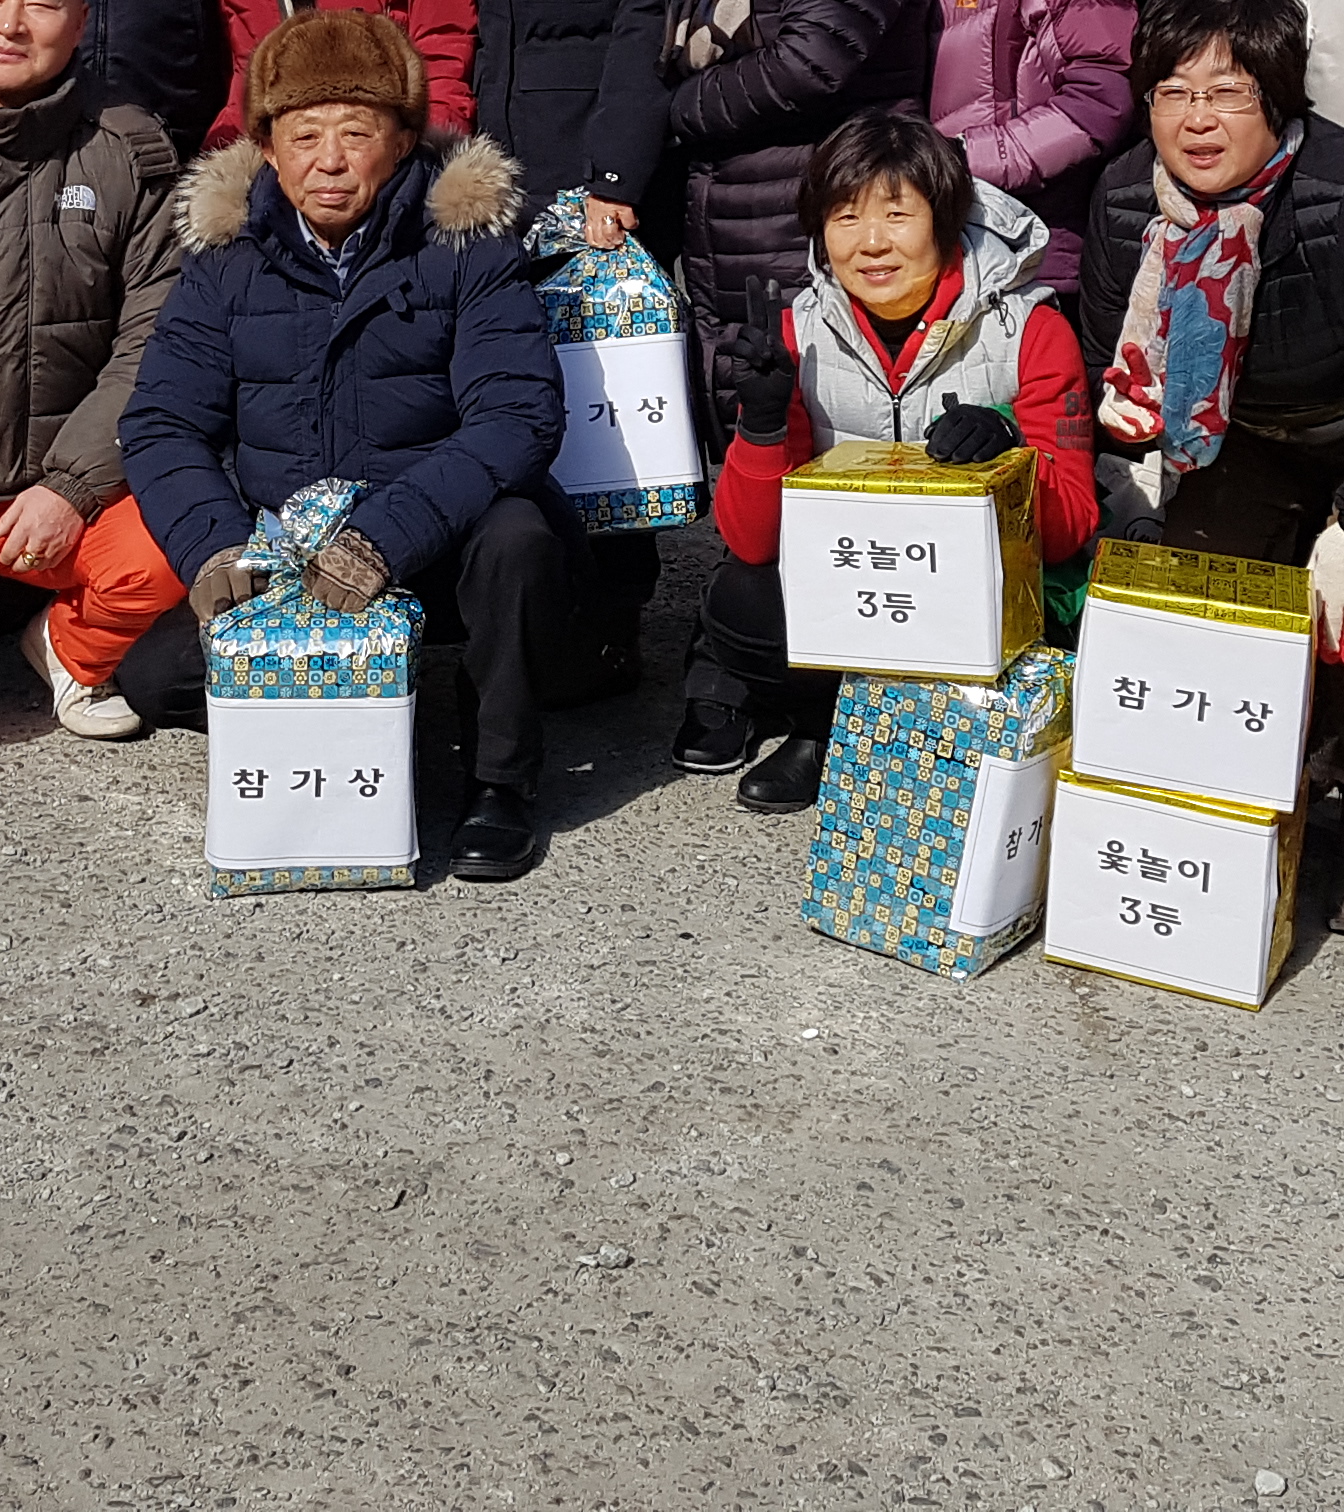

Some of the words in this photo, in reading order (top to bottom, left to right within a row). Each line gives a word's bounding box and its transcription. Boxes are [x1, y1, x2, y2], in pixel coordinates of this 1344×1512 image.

[829, 536, 937, 573] 윷놀이
[857, 590, 916, 624] 3등
[1097, 840, 1210, 893] 윷놀이
[1119, 896, 1182, 936] 3등
